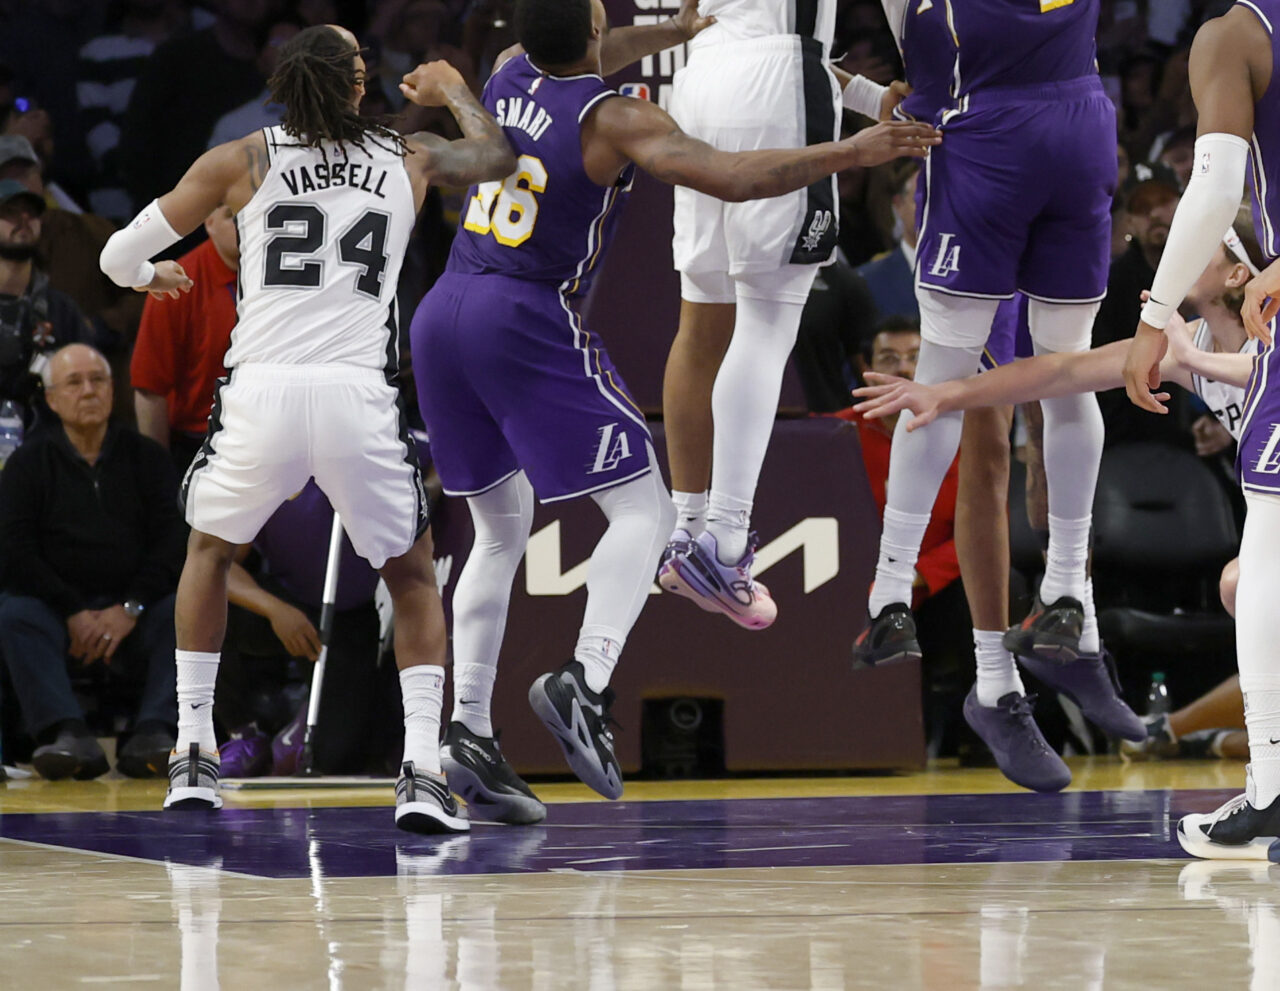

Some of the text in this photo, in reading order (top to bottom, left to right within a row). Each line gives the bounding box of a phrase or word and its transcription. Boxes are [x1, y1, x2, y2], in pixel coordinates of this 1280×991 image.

[496, 97, 552, 142] SMART
[280, 162, 387, 199] VASSELL
[260, 200, 392, 304] 24
[928, 232, 961, 277] LA
[587, 422, 633, 475] LA
